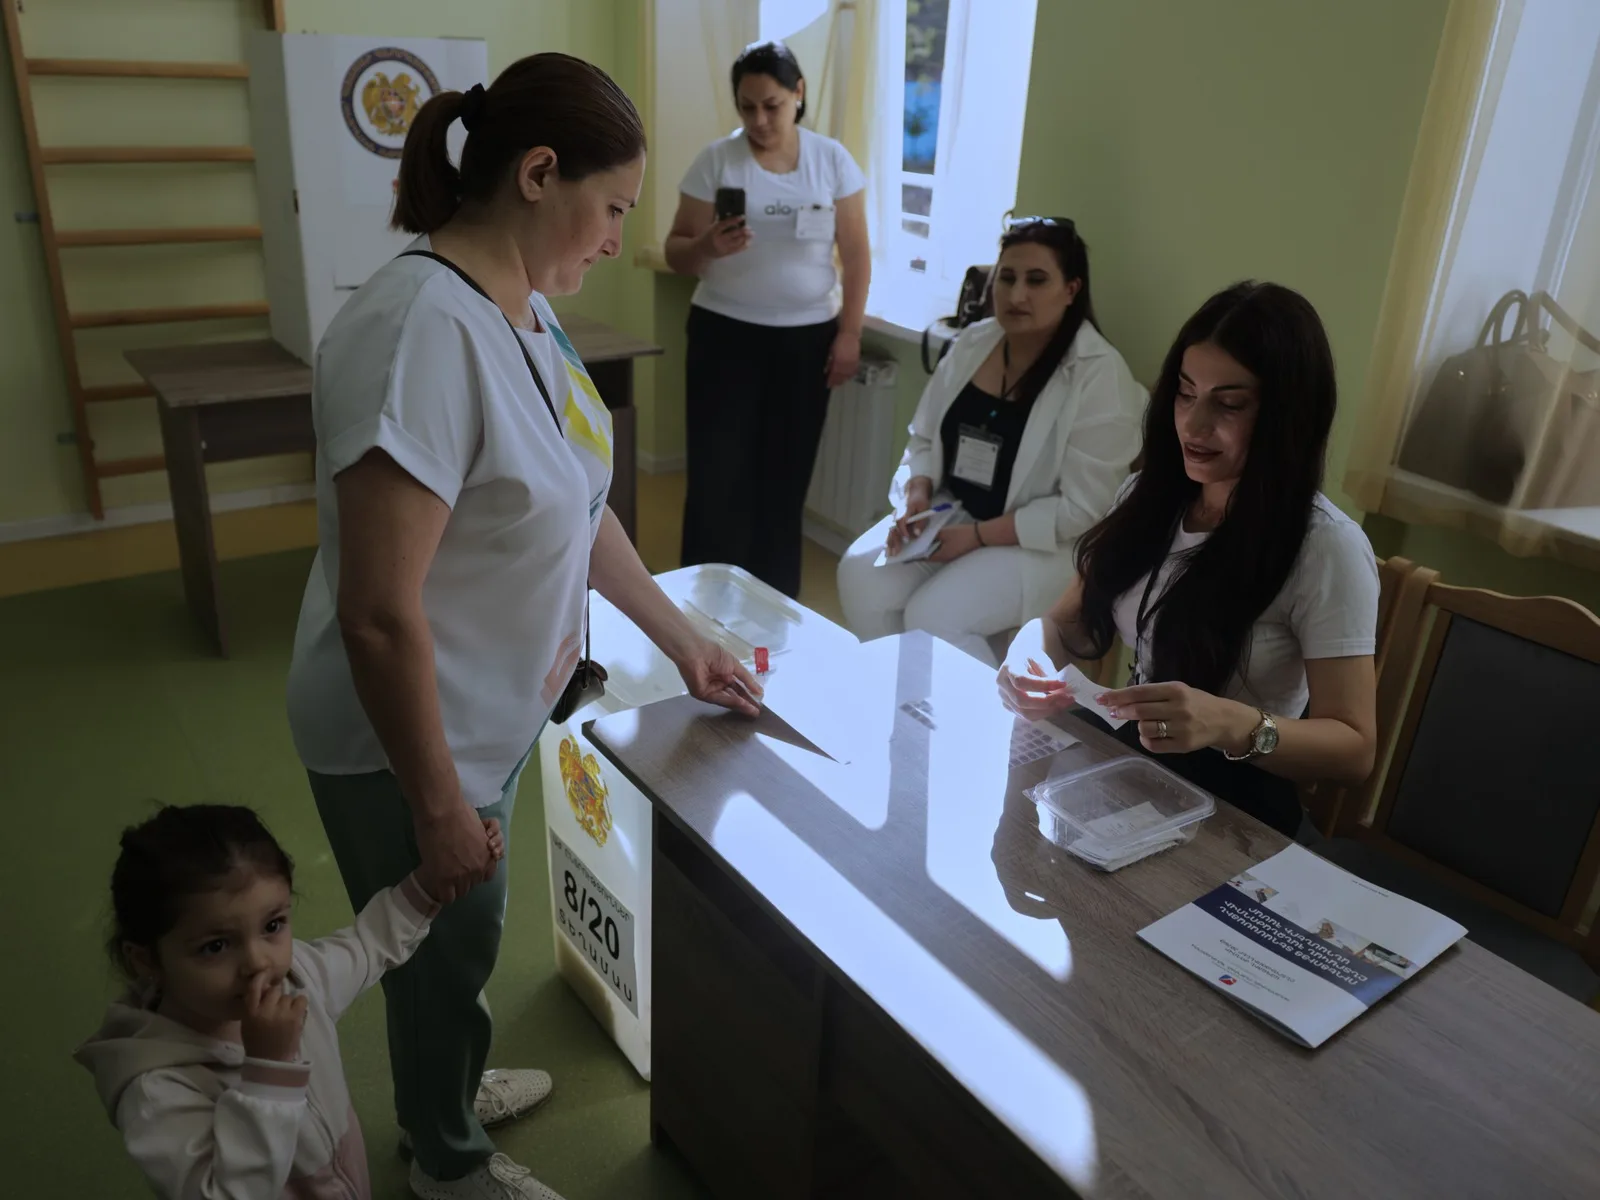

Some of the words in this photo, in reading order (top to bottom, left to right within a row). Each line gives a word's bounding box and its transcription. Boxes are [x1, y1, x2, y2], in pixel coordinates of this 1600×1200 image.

[764, 199, 792, 216] alo
[564, 869, 620, 960] 8/20
[1248, 907, 1282, 929] ՀԱՄԱՐ
